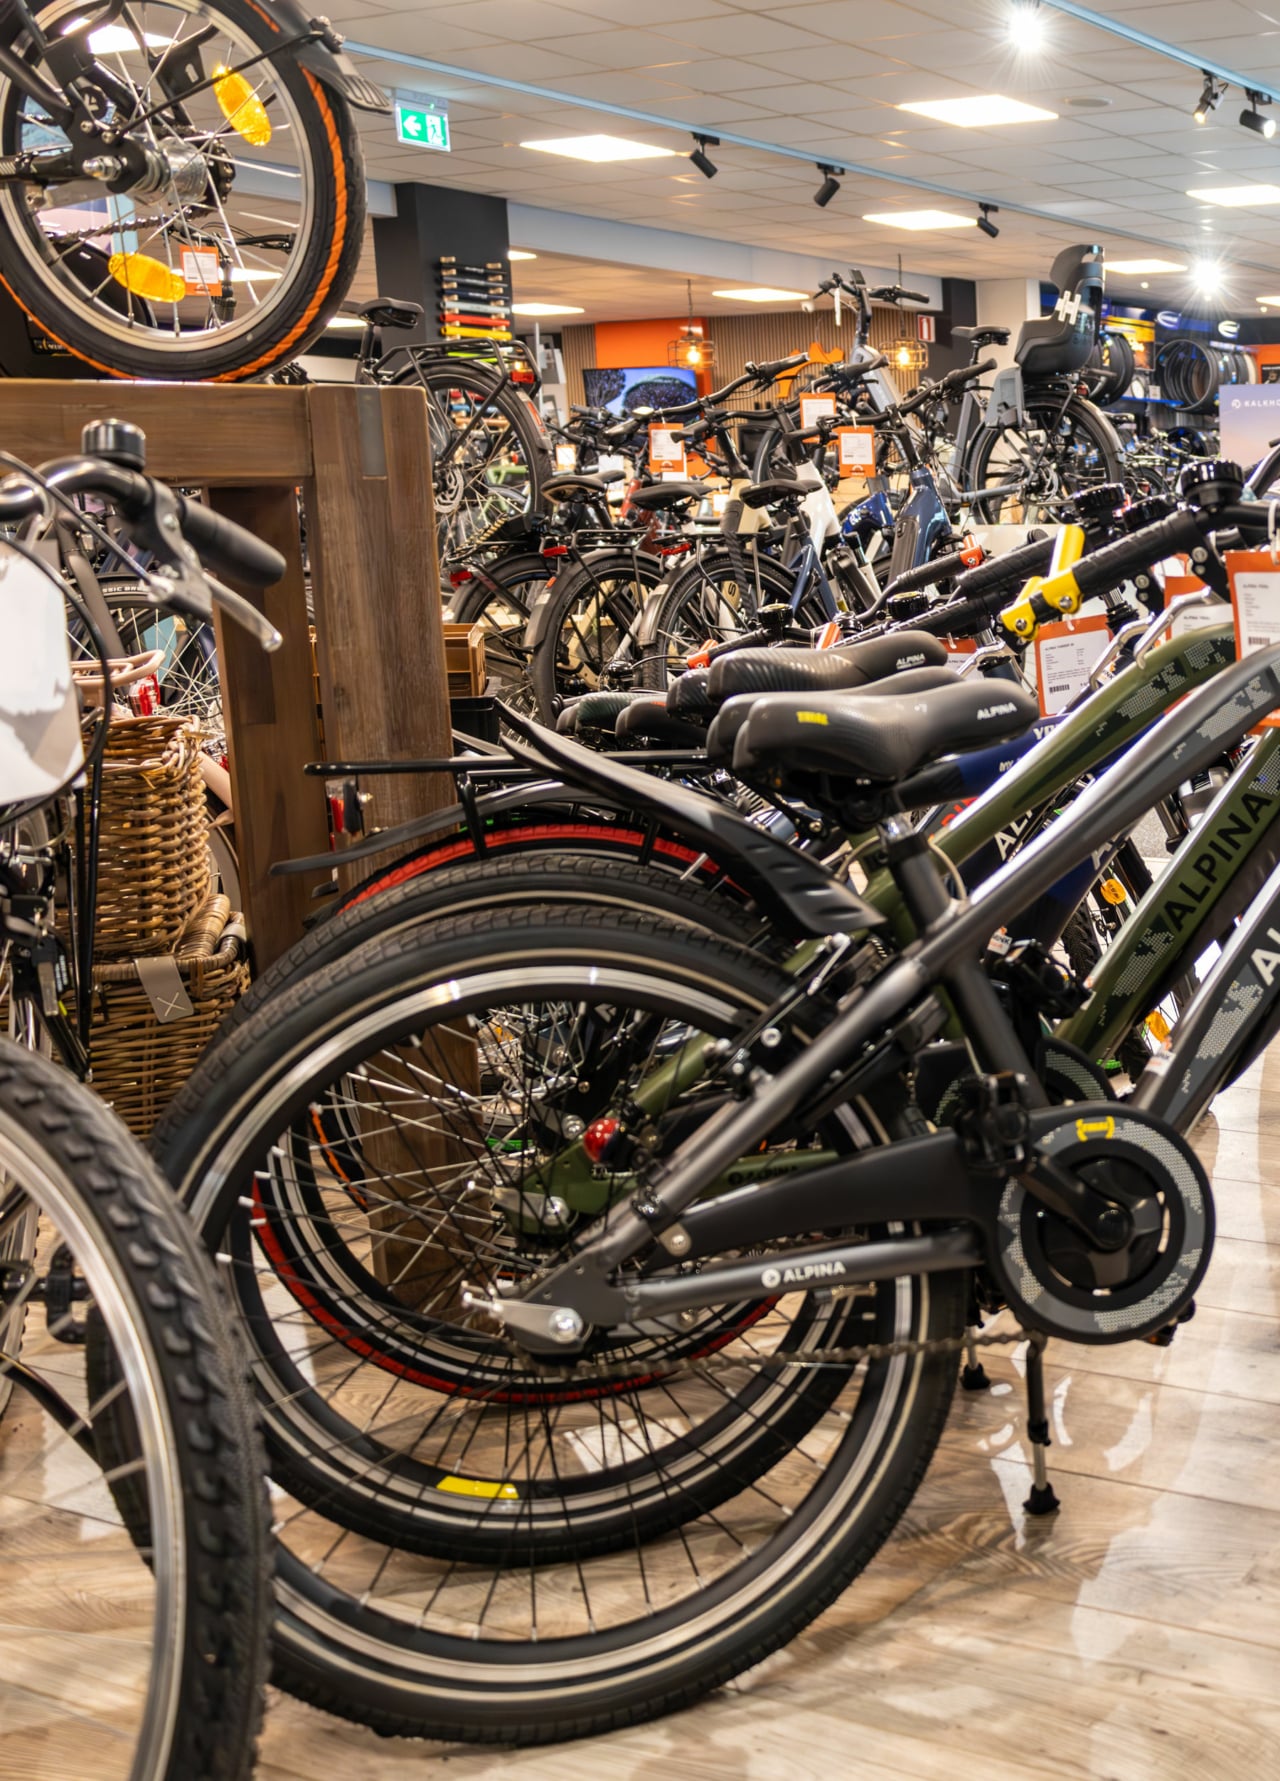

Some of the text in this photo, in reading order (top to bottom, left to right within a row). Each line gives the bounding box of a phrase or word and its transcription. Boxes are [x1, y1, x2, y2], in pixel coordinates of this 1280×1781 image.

[896, 653, 926, 666] ALPINA
[977, 702, 1018, 720] ALPINA
[994, 809, 1033, 861] AL
[1163, 791, 1273, 932] ALPINA
[783, 1261, 847, 1283] ALPINA
